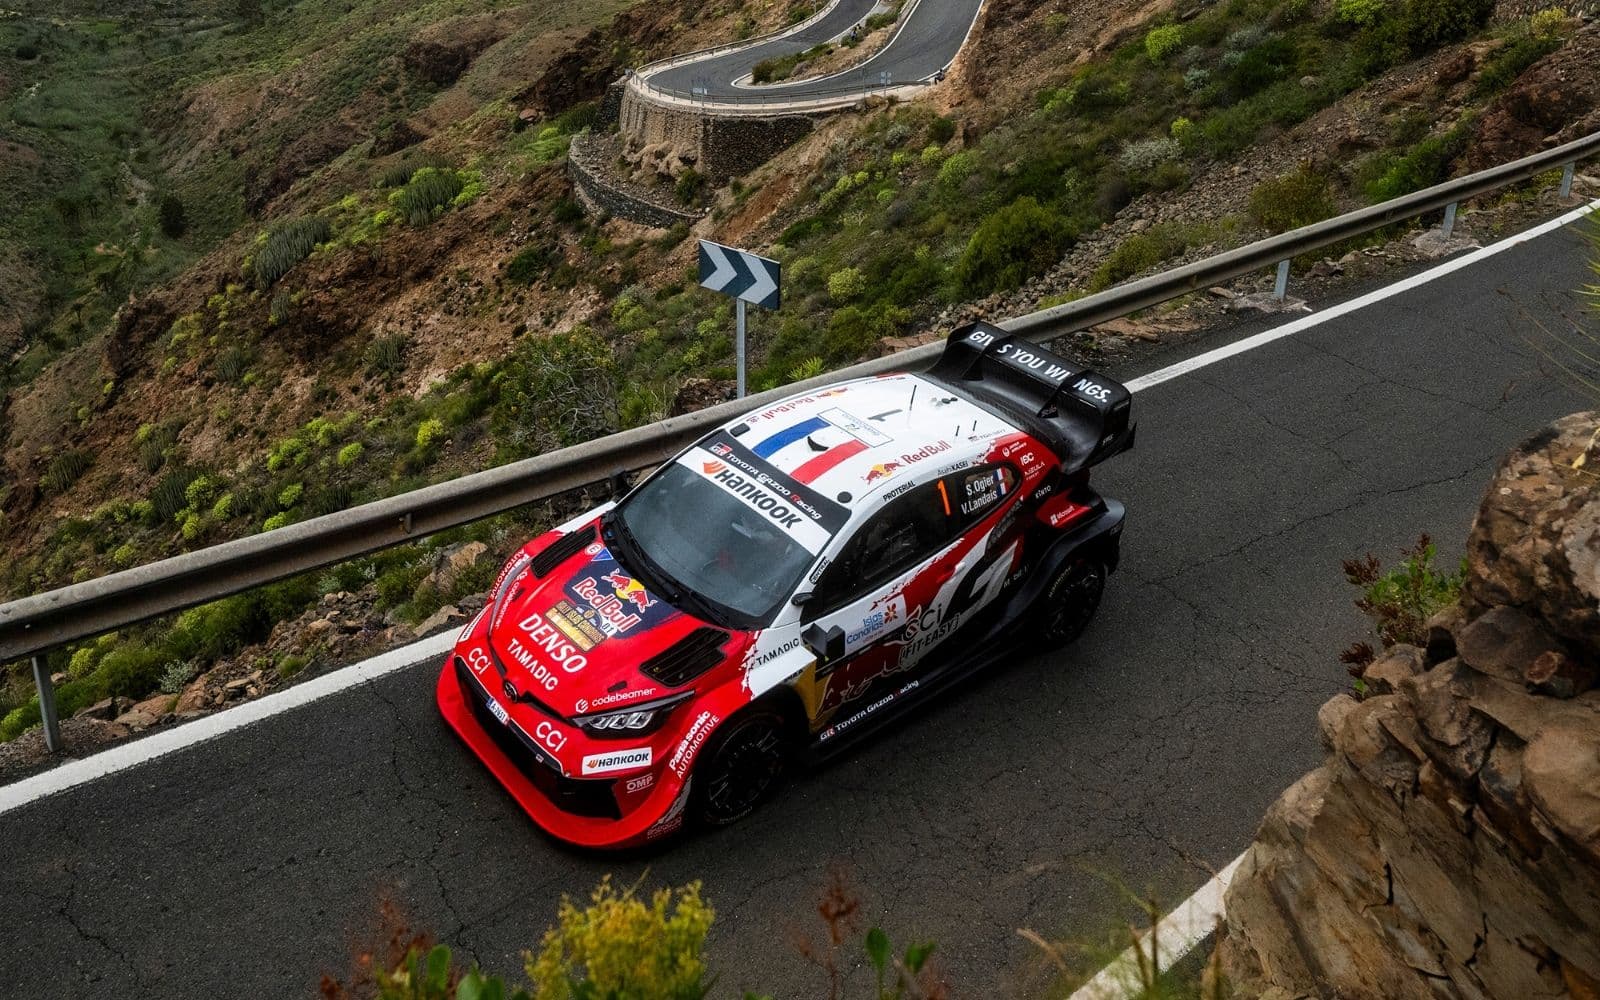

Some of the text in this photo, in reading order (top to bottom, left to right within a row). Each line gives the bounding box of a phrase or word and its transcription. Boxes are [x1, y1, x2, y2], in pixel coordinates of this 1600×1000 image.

[969, 331, 1013, 354] GIS
[1010, 348, 1048, 370] YOU
[868, 409, 903, 423] 1
[726, 453, 760, 476] TOYOTA
[758, 472, 791, 496] GAZOO
[790, 494, 822, 519] Racing
[883, 480, 916, 502] PROTERIAL
[937, 479, 951, 516] 1
[518, 613, 588, 673] DENSO
[756, 638, 799, 666] TAMADIC
[507, 638, 559, 691] TAMADIC
[591, 688, 656, 707] codebeamer
[835, 710, 866, 731] TOYOTA
[866, 694, 894, 713] GAZOO
[669, 710, 711, 772] Panasonic
[676, 714, 720, 779] AUTOMOTIVE
[626, 775, 653, 791] OMP
